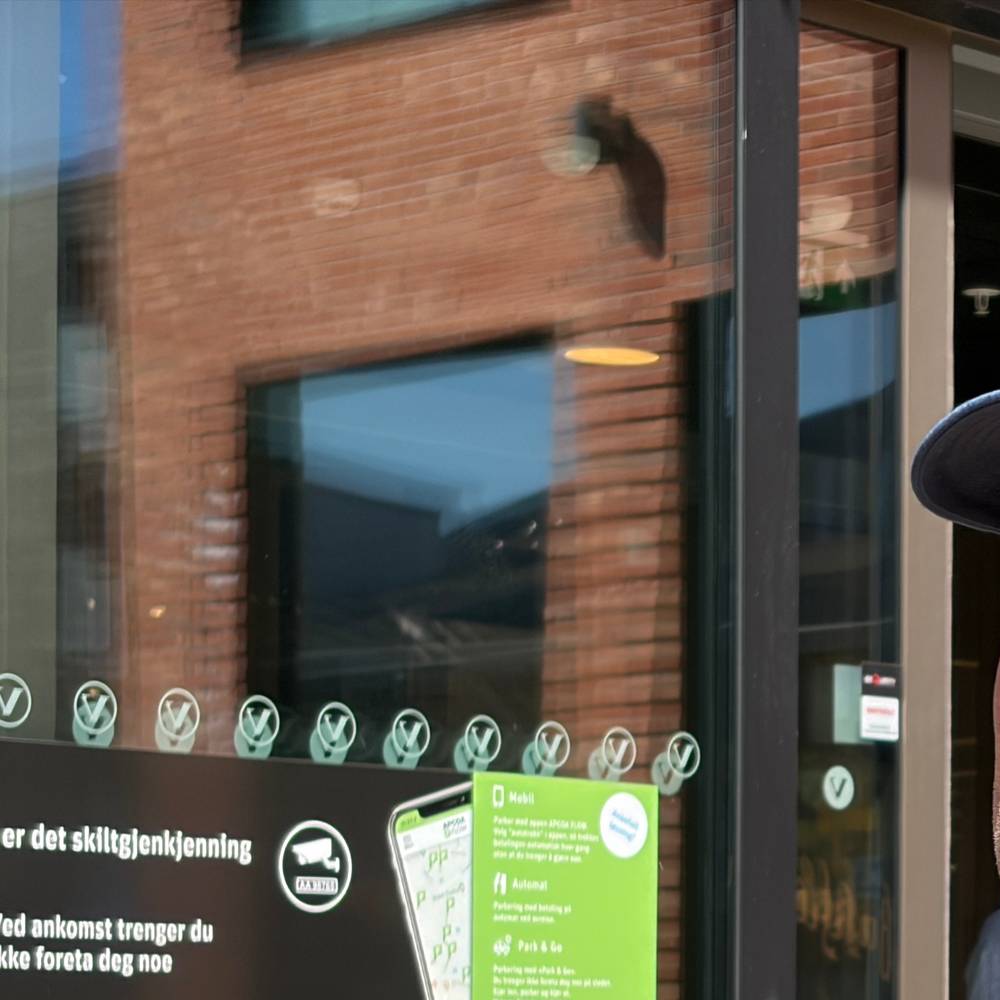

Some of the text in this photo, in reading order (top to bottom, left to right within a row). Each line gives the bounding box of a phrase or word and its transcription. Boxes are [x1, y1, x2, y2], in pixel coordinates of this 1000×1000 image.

[2, 823, 252, 865] er det skiltgjenkjenning
[512, 878, 548, 891] Automat
[0, 912, 213, 946] ed ankomst trenger du
[36, 945, 93, 971] foreta
[99, 948, 133, 977] deg
[138, 953, 173, 974] noe
